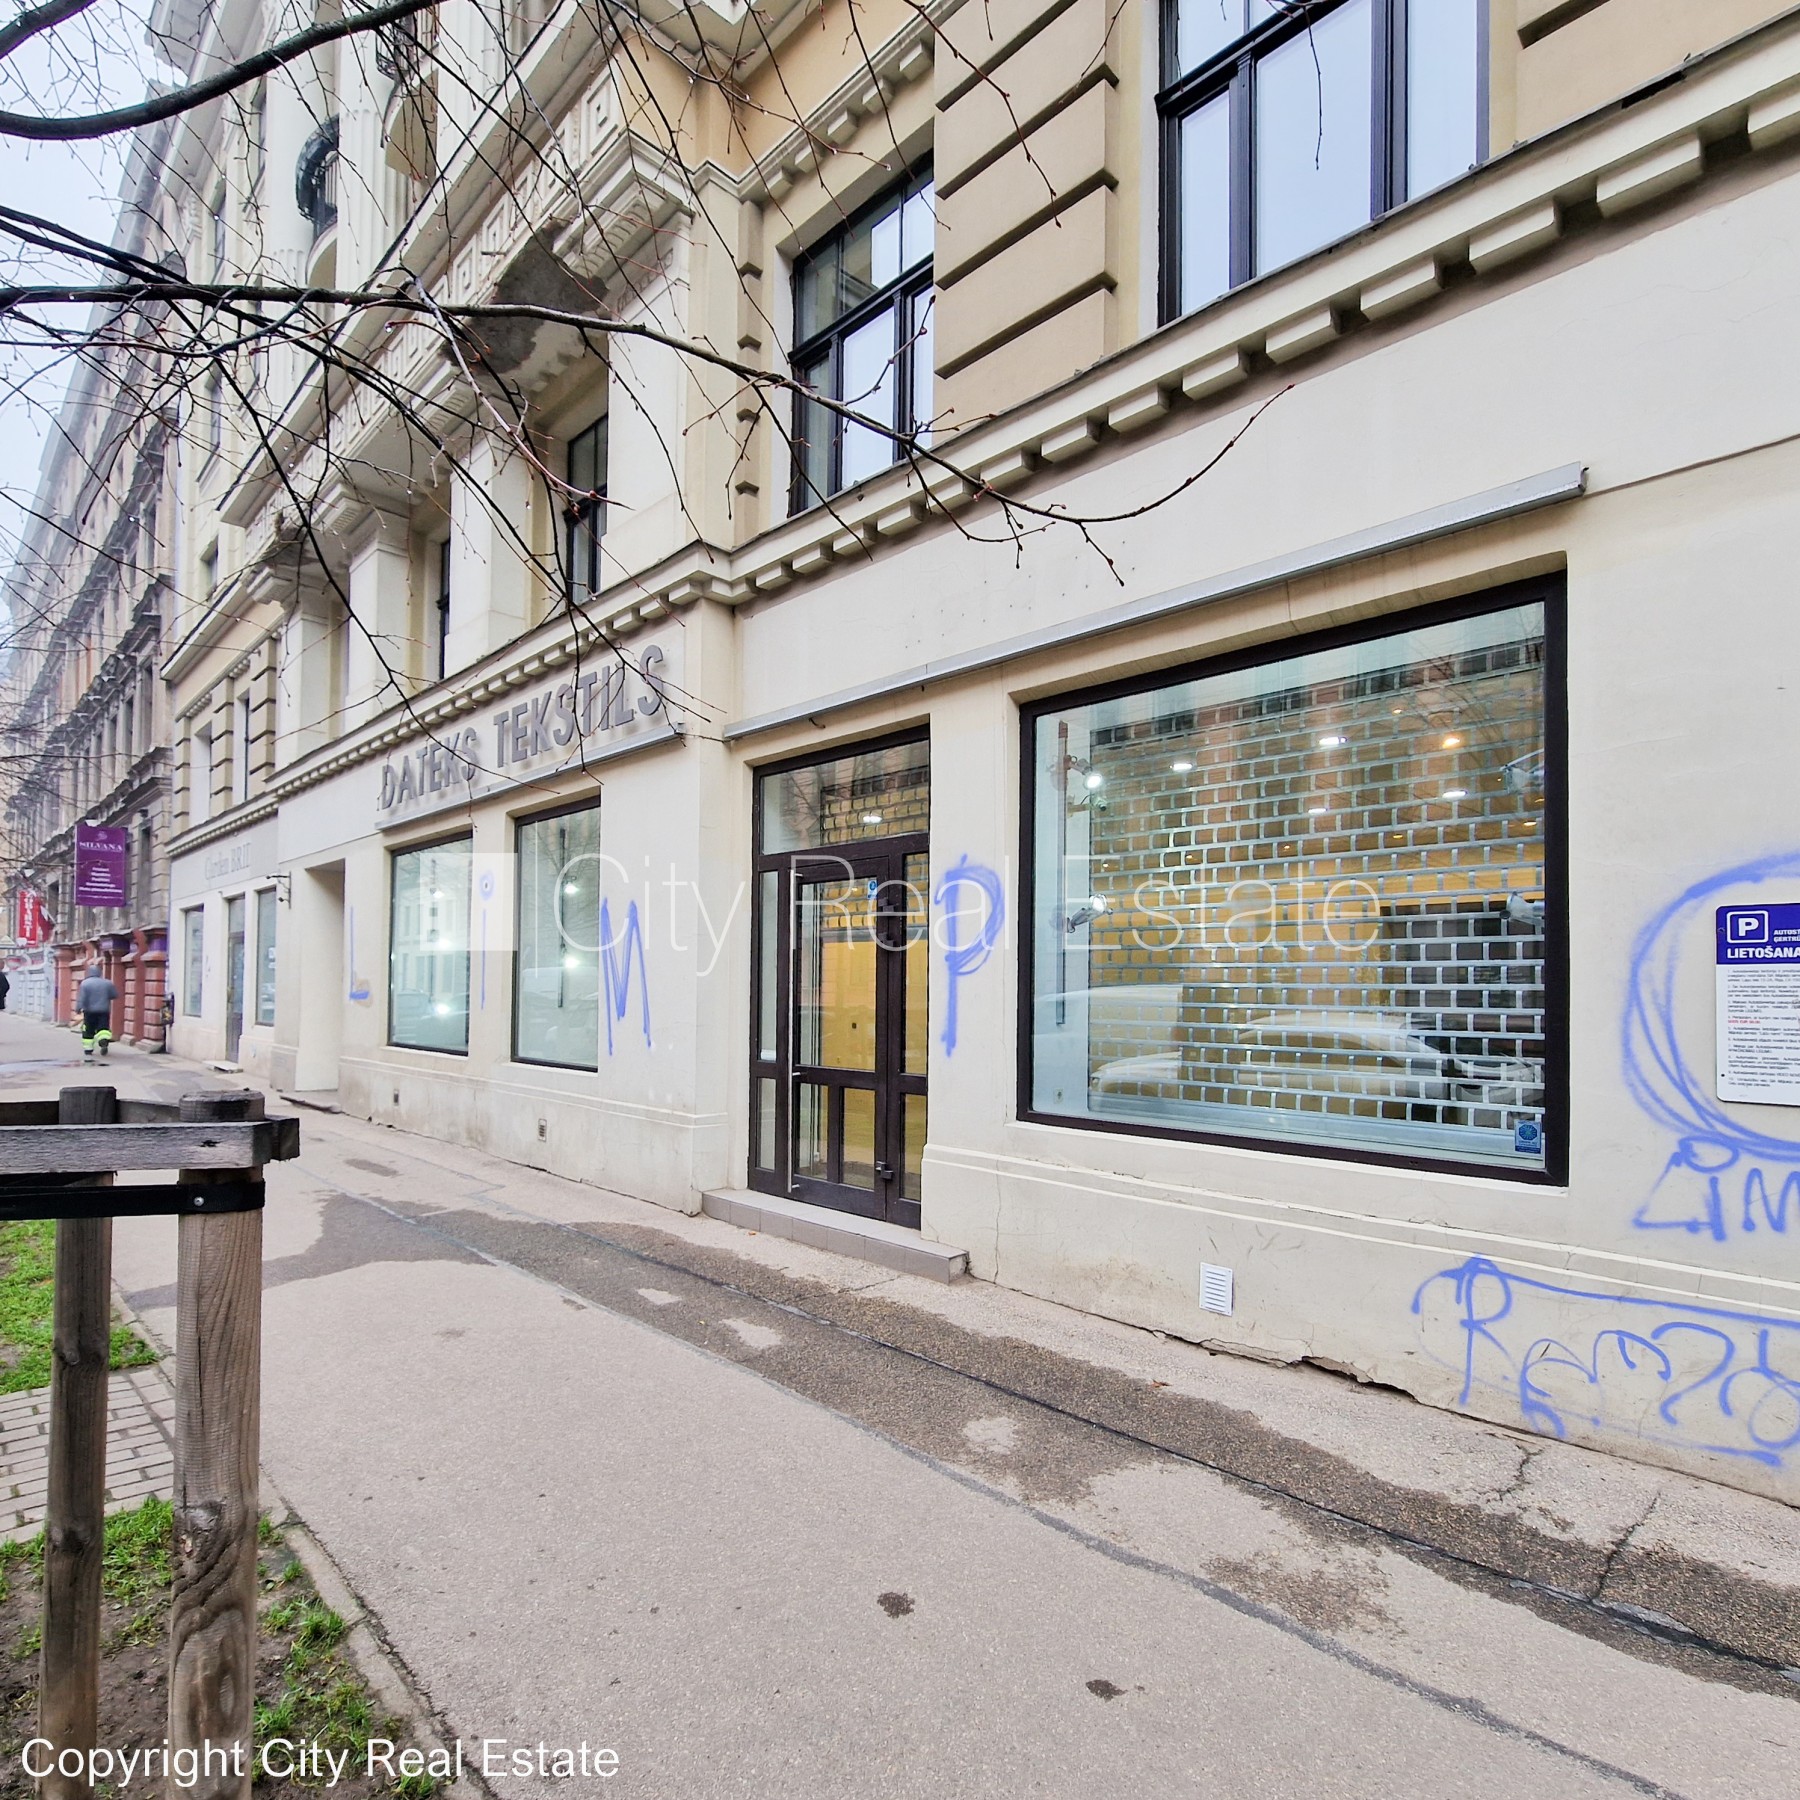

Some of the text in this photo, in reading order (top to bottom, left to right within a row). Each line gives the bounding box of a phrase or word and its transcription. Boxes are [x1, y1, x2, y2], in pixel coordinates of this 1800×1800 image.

[380, 645, 664, 811] DATEKS TEKSTILS
[1738, 917, 1760, 937] P
